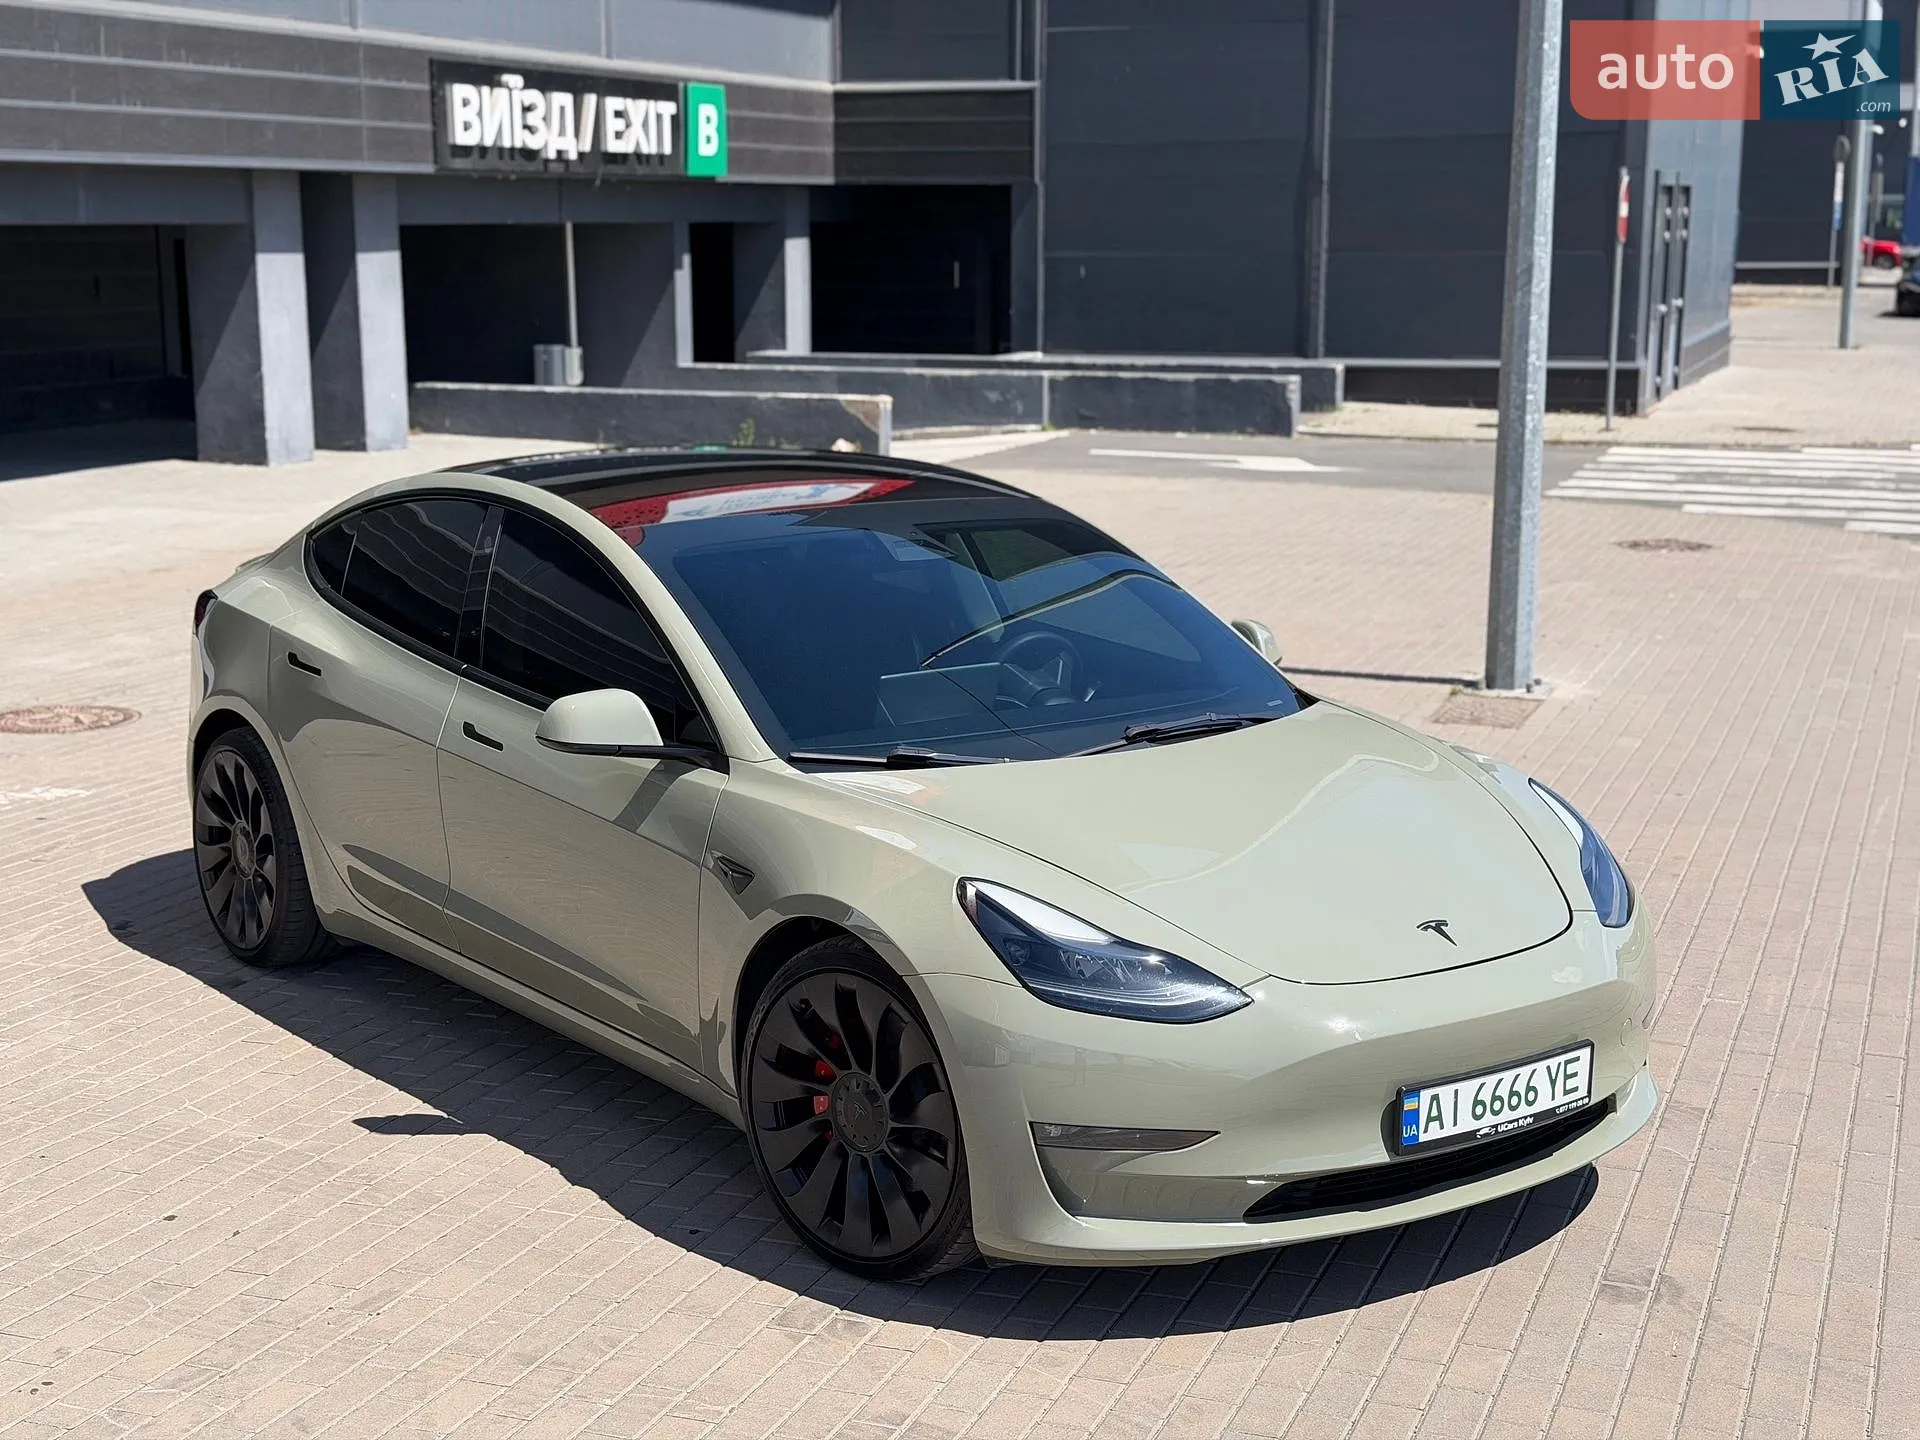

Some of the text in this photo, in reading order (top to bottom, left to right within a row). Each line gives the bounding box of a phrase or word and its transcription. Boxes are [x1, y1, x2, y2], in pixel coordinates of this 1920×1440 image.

[450, 73, 578, 161] ВИЇЗД
[603, 96, 678, 155] EXIT
[1403, 1124, 1418, 1138] UA
[1423, 1055, 1581, 1134] AI 6666 YE
